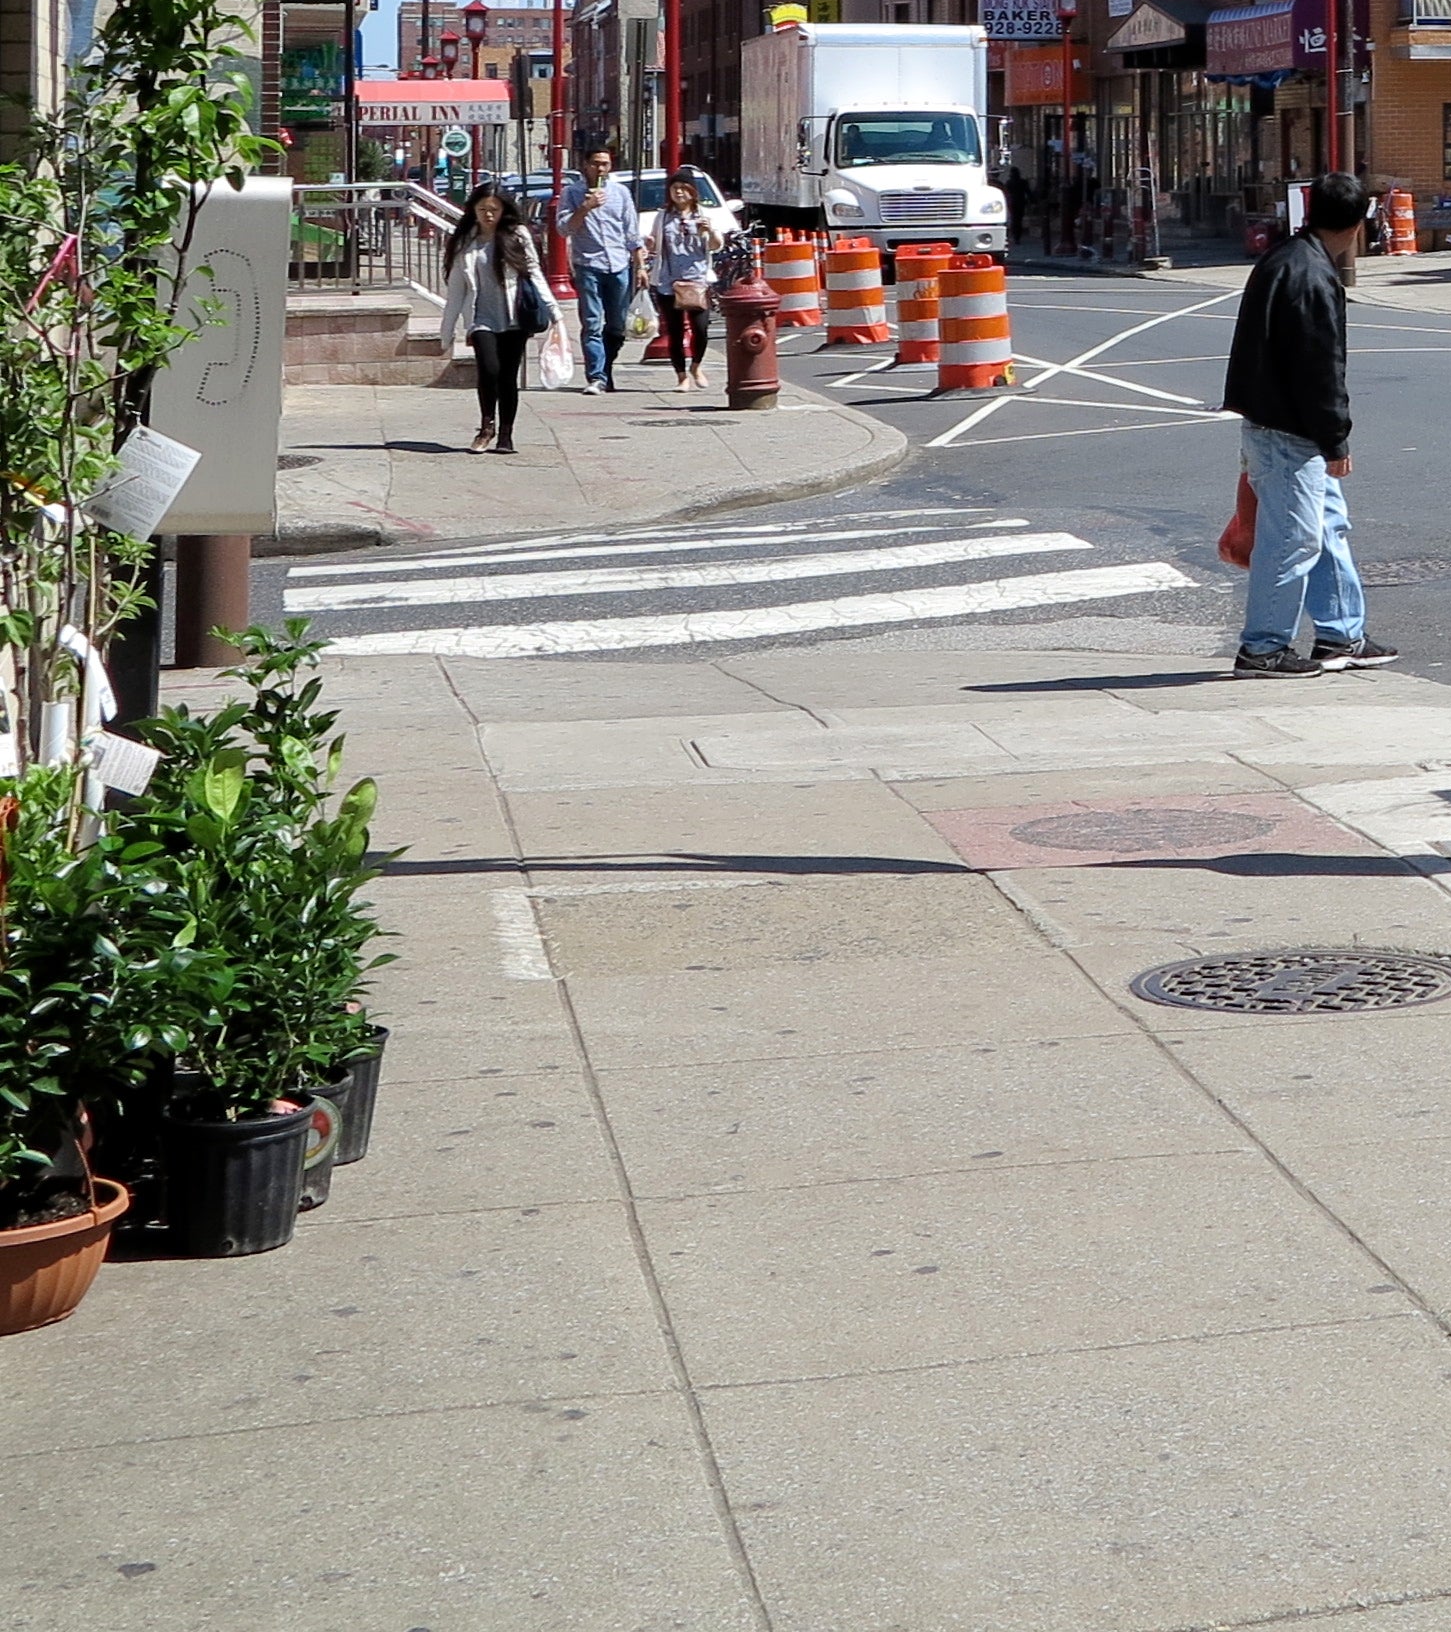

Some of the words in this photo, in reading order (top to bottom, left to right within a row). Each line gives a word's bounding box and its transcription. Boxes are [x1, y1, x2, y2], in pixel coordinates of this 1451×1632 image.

[984, 10, 1061, 22] BAKER
[985, 22, 1064, 35] 928-9228
[431, 105, 461, 121] INN
